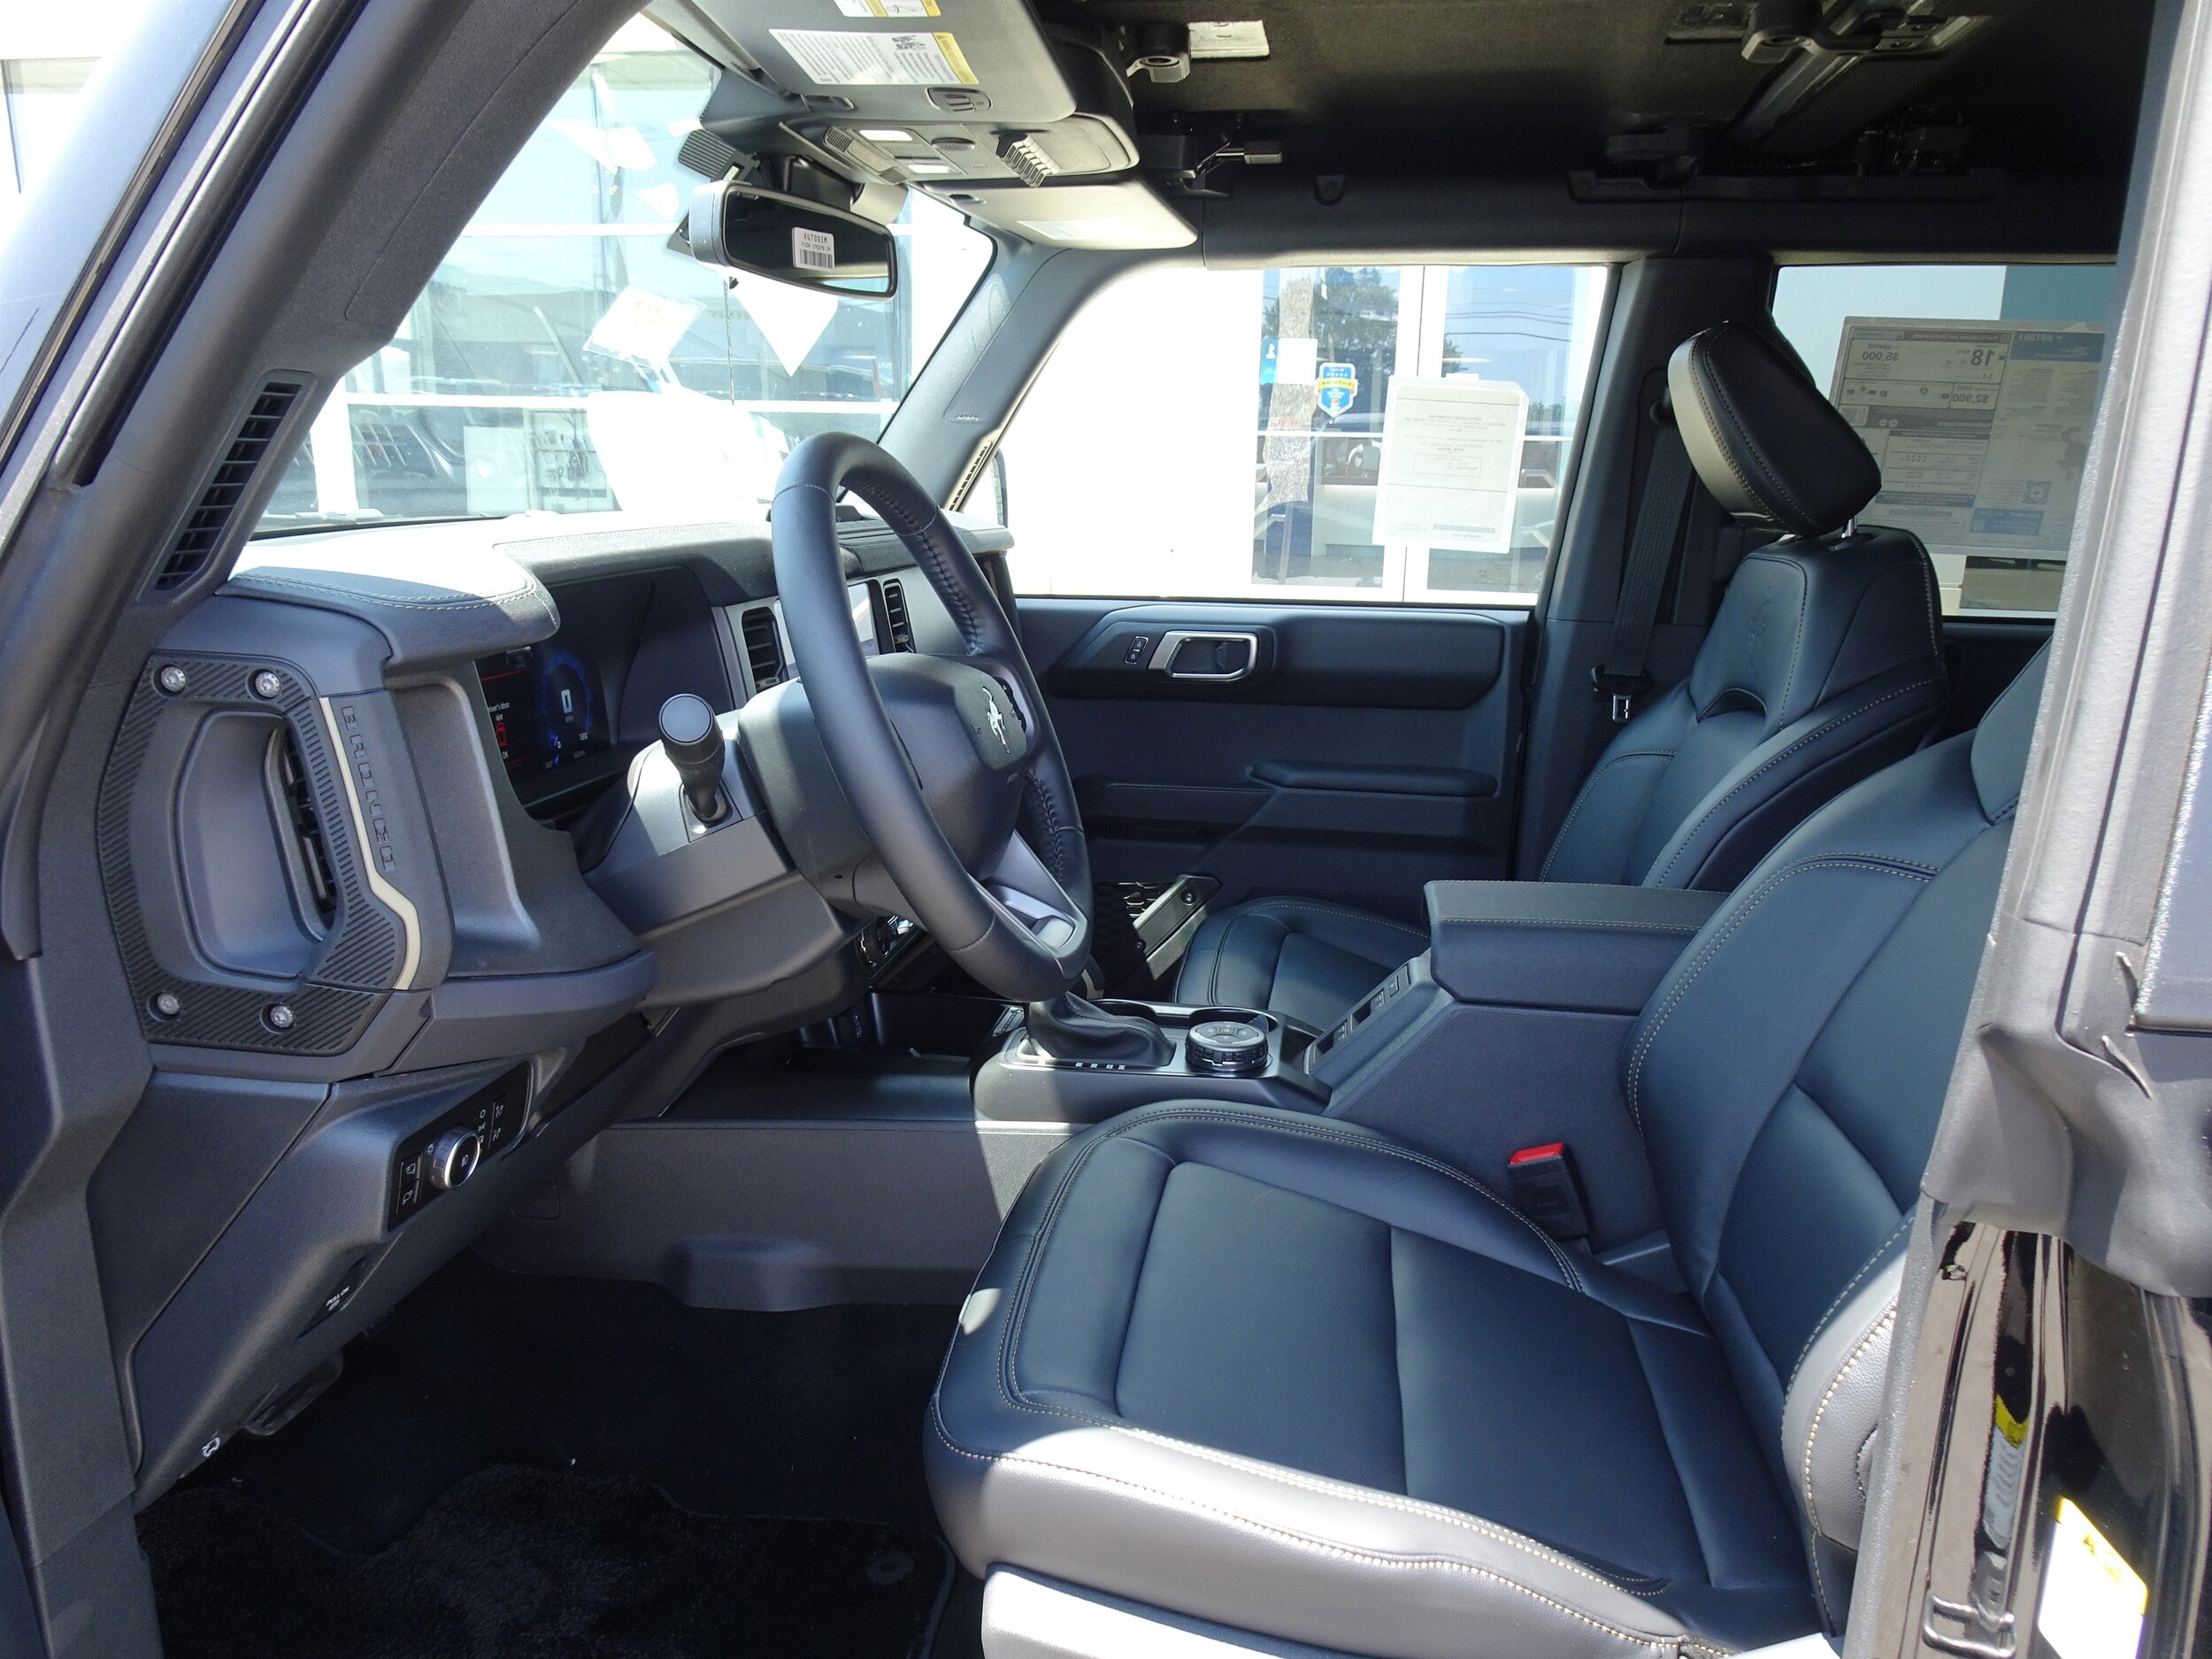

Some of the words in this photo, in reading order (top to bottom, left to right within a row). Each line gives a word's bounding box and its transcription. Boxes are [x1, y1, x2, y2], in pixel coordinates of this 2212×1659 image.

[803, 233, 827, 244] AUTODIM
[561, 689, 572, 713] 0
[341, 706, 396, 871] BRONCO
